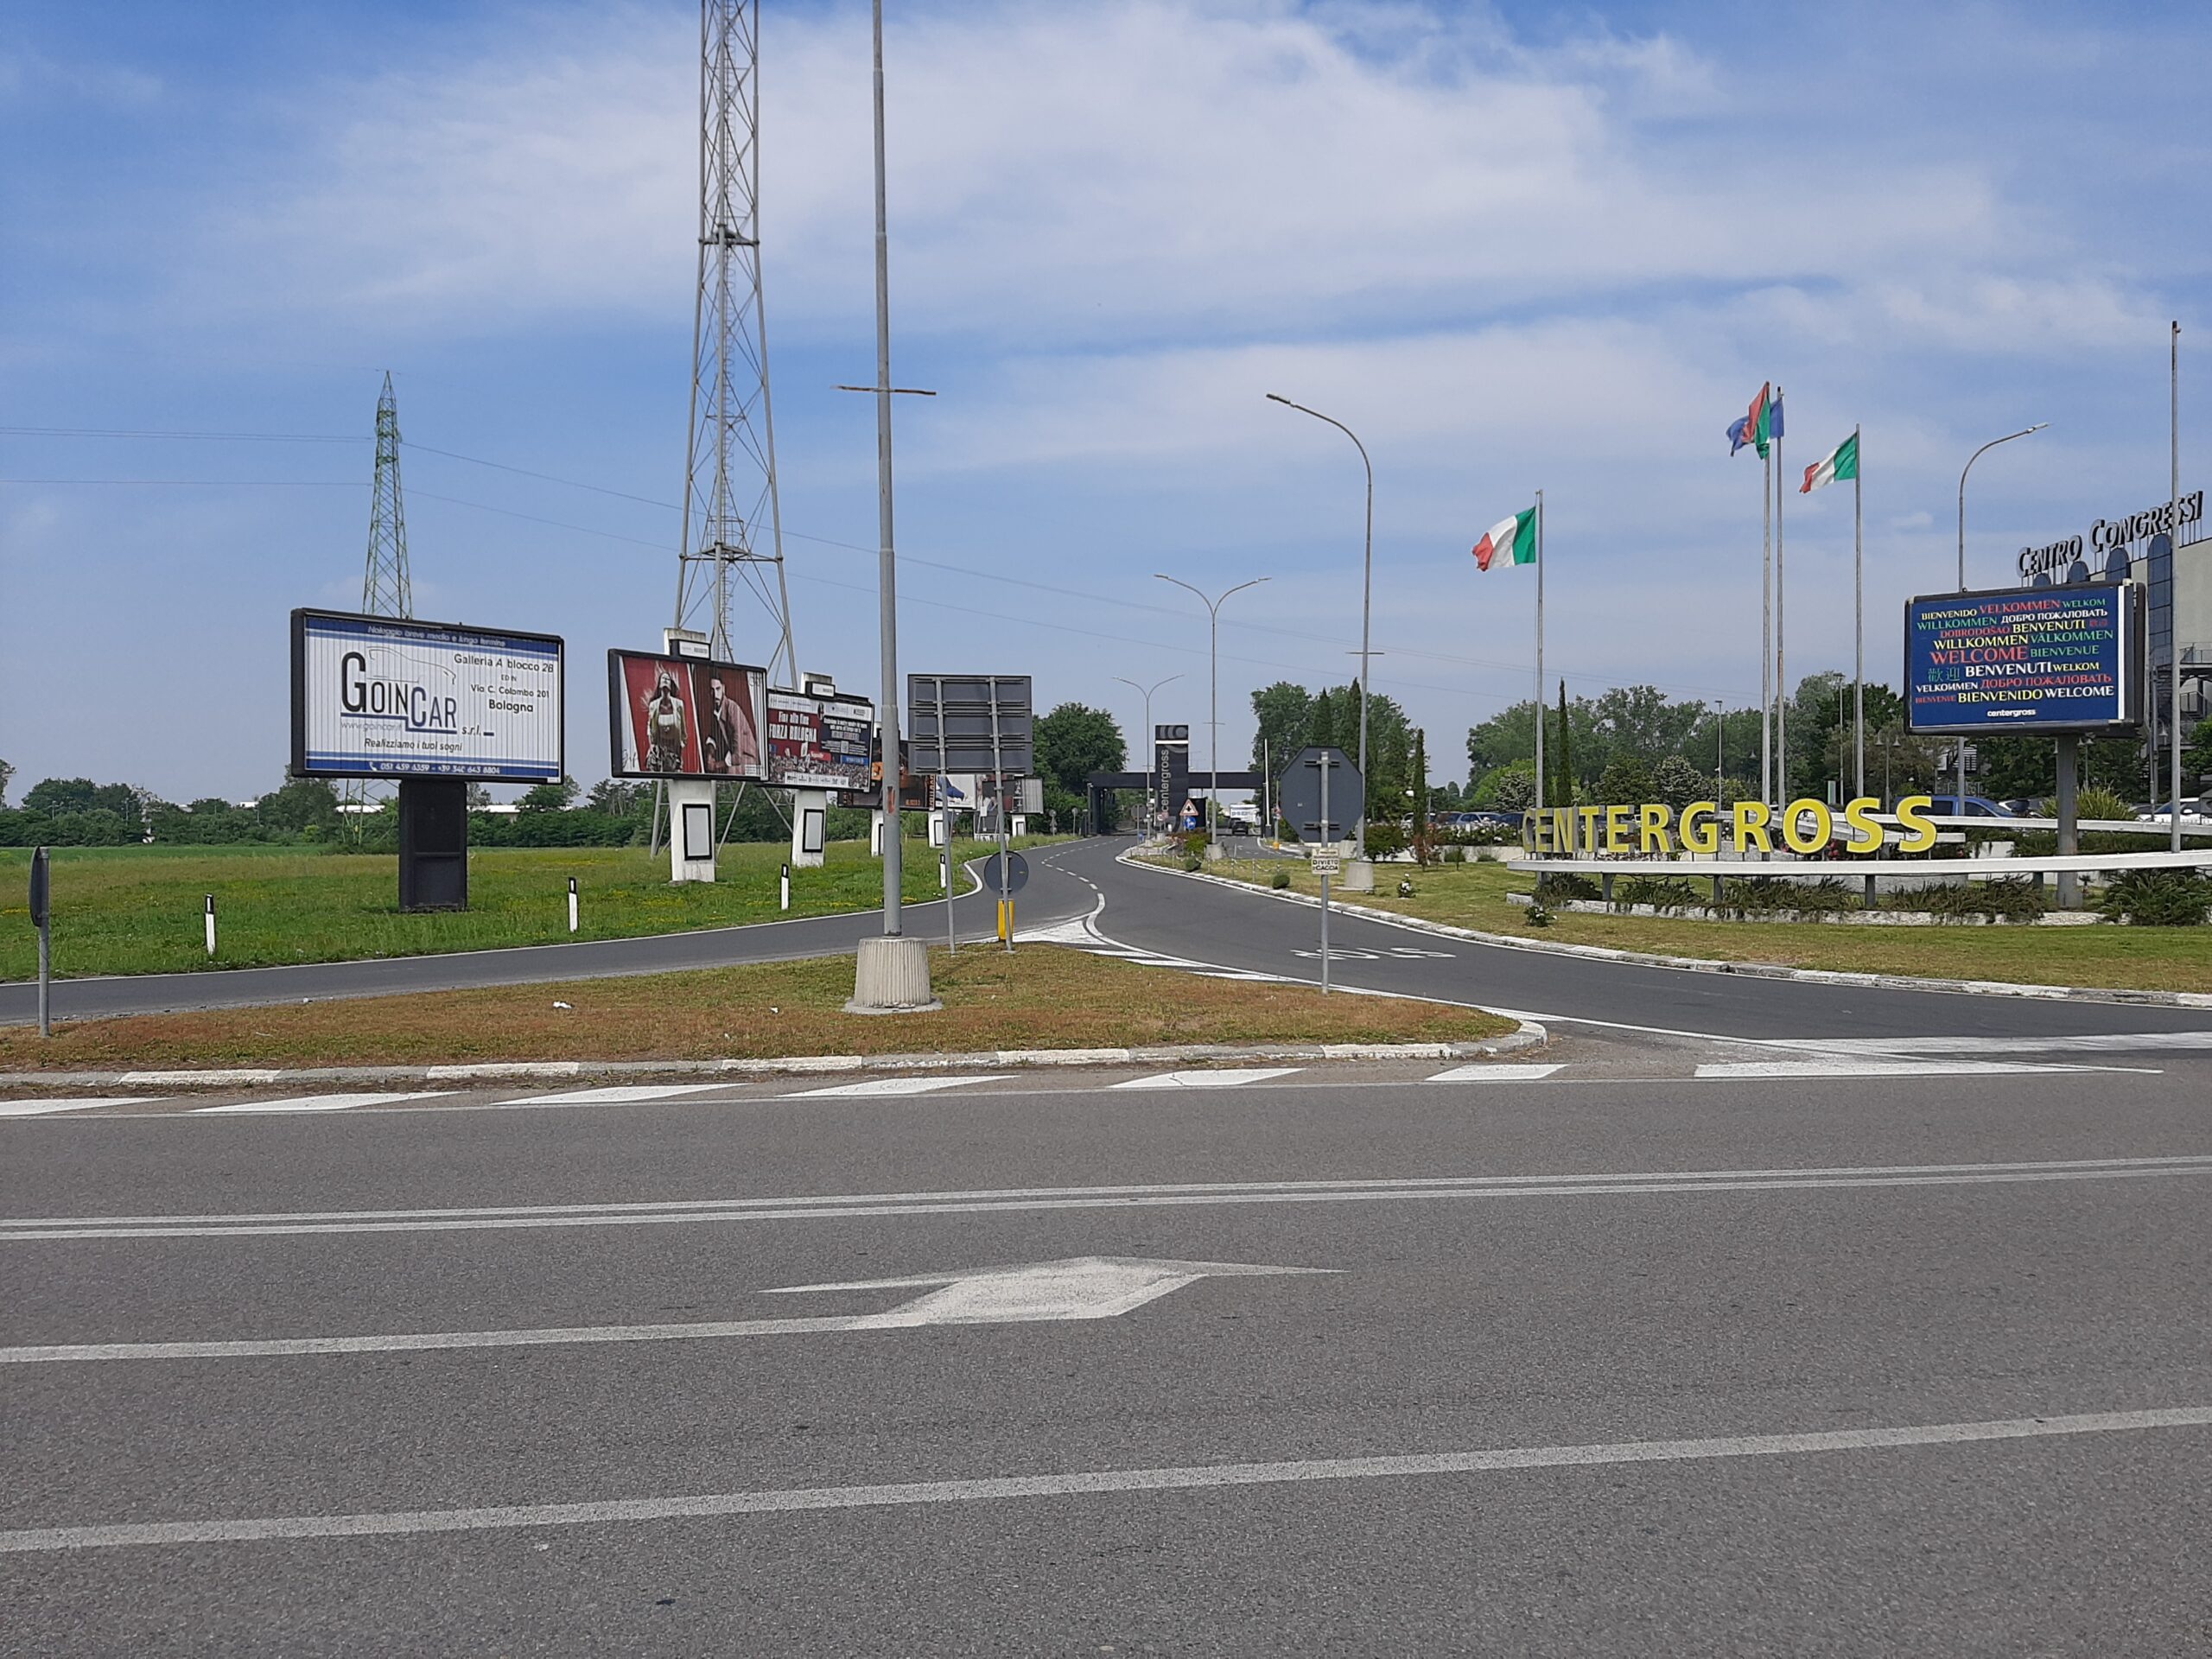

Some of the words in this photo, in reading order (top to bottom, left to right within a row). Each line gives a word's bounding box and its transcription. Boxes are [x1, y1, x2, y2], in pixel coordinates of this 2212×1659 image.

[2017, 535, 2083, 578] CENTRO
[2089, 491, 2203, 554] CONGRESSI
[1921, 609, 1978, 621] BIENVENIDO
[1980, 600, 2062, 615] VELKOMMEN
[2063, 598, 2107, 609] WELKOM
[1916, 617, 1999, 632] WILLKOMMEN
[2001, 613, 2036, 625] ДОБРО
[2037, 608, 2109, 621] ПОЖАЛОВАТЬ
[2012, 620, 2087, 633] BENVENUTI
[1933, 635, 2029, 651] WILLKOMMEN
[2031, 629, 2114, 645] VÄLKOMMEN
[454, 653, 493, 666] Galleria
[495, 658, 503, 668] A
[507, 658, 540, 671] blocco
[1929, 645, 2029, 665] WELCOME
[2031, 645, 2101, 658] BIENVENUE
[1965, 661, 2052, 678] BENVENUTI
[2052, 662, 2101, 673] WELKOM
[471, 683, 485, 692] Via
[499, 686, 534, 696] Colombo
[537, 690, 550, 698] 201
[1915, 682, 1979, 694] VELKOMMEN
[1980, 676, 2023, 690] ДОБРО
[2024, 674, 2113, 688] ПОЖАЛОВАТЬ
[1957, 690, 2044, 704] BIENVENIDO
[2044, 685, 2115, 699] WELCOME
[488, 699, 534, 714] Bologna
[1986, 708, 2037, 718] centergross
[768, 723, 788, 740] FORZA
[789, 725, 817, 743] BOLOGNA
[364, 738, 415, 750] Realizziamo
[439, 741, 463, 753] sogni
[1161, 748, 1172, 813] centergross
[1522, 795, 1937, 855] CENTERGROSS
